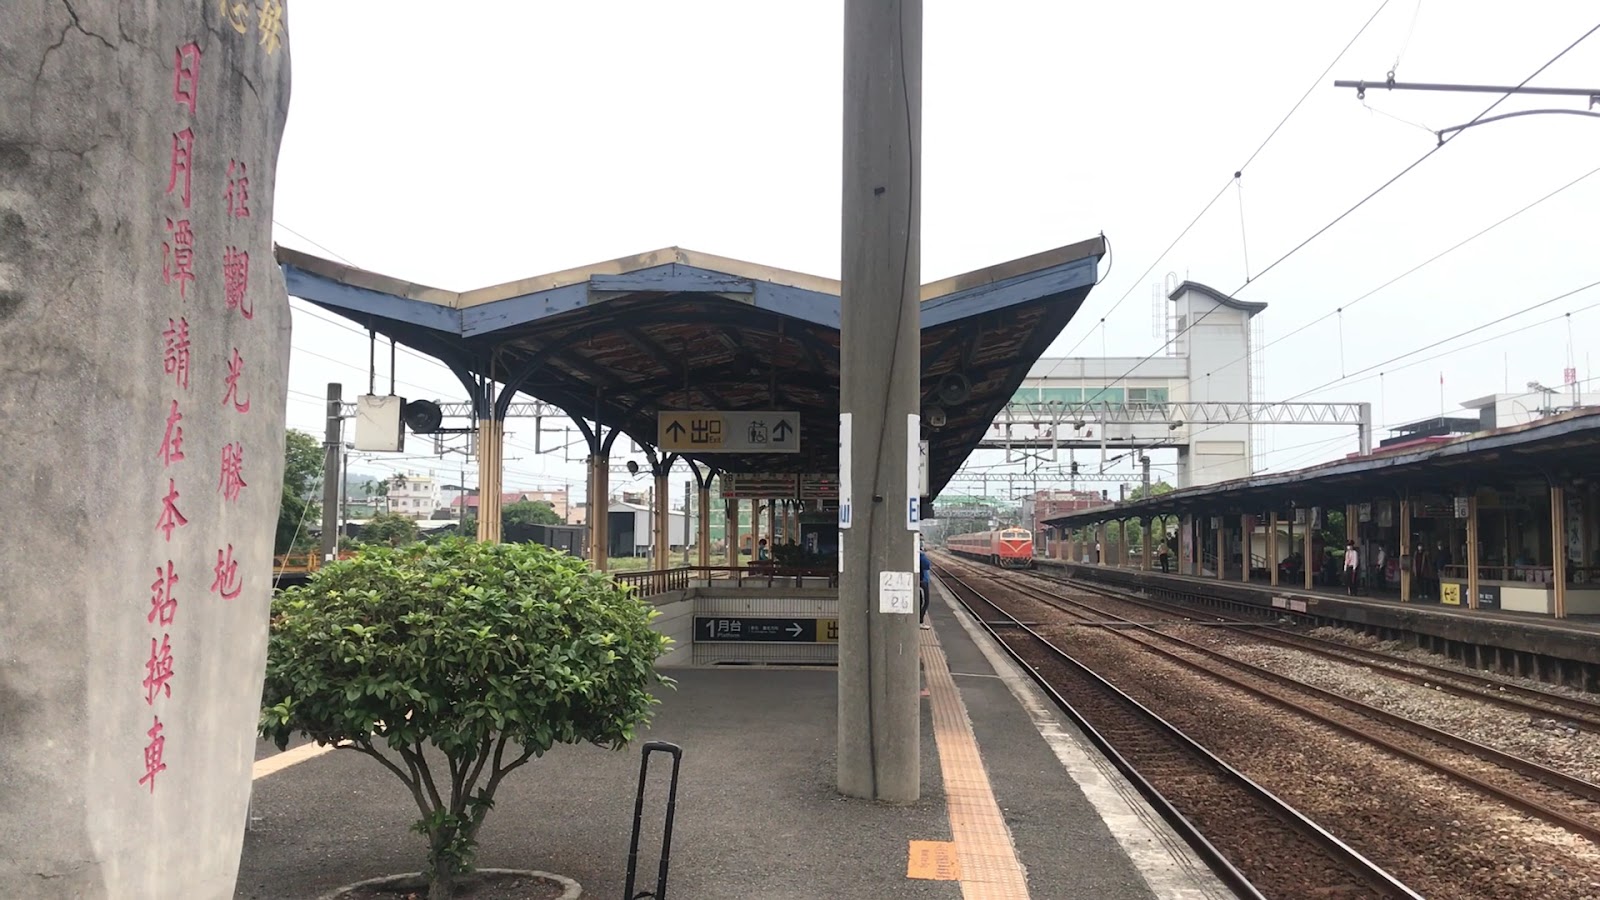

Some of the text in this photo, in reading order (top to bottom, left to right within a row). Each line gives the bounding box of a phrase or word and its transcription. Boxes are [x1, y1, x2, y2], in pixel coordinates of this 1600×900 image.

[138, 40, 202, 794] 日月潭請在本站換車
[210, 158, 253, 600] 往觀光勝地
[691, 419, 721, 443] 出口
